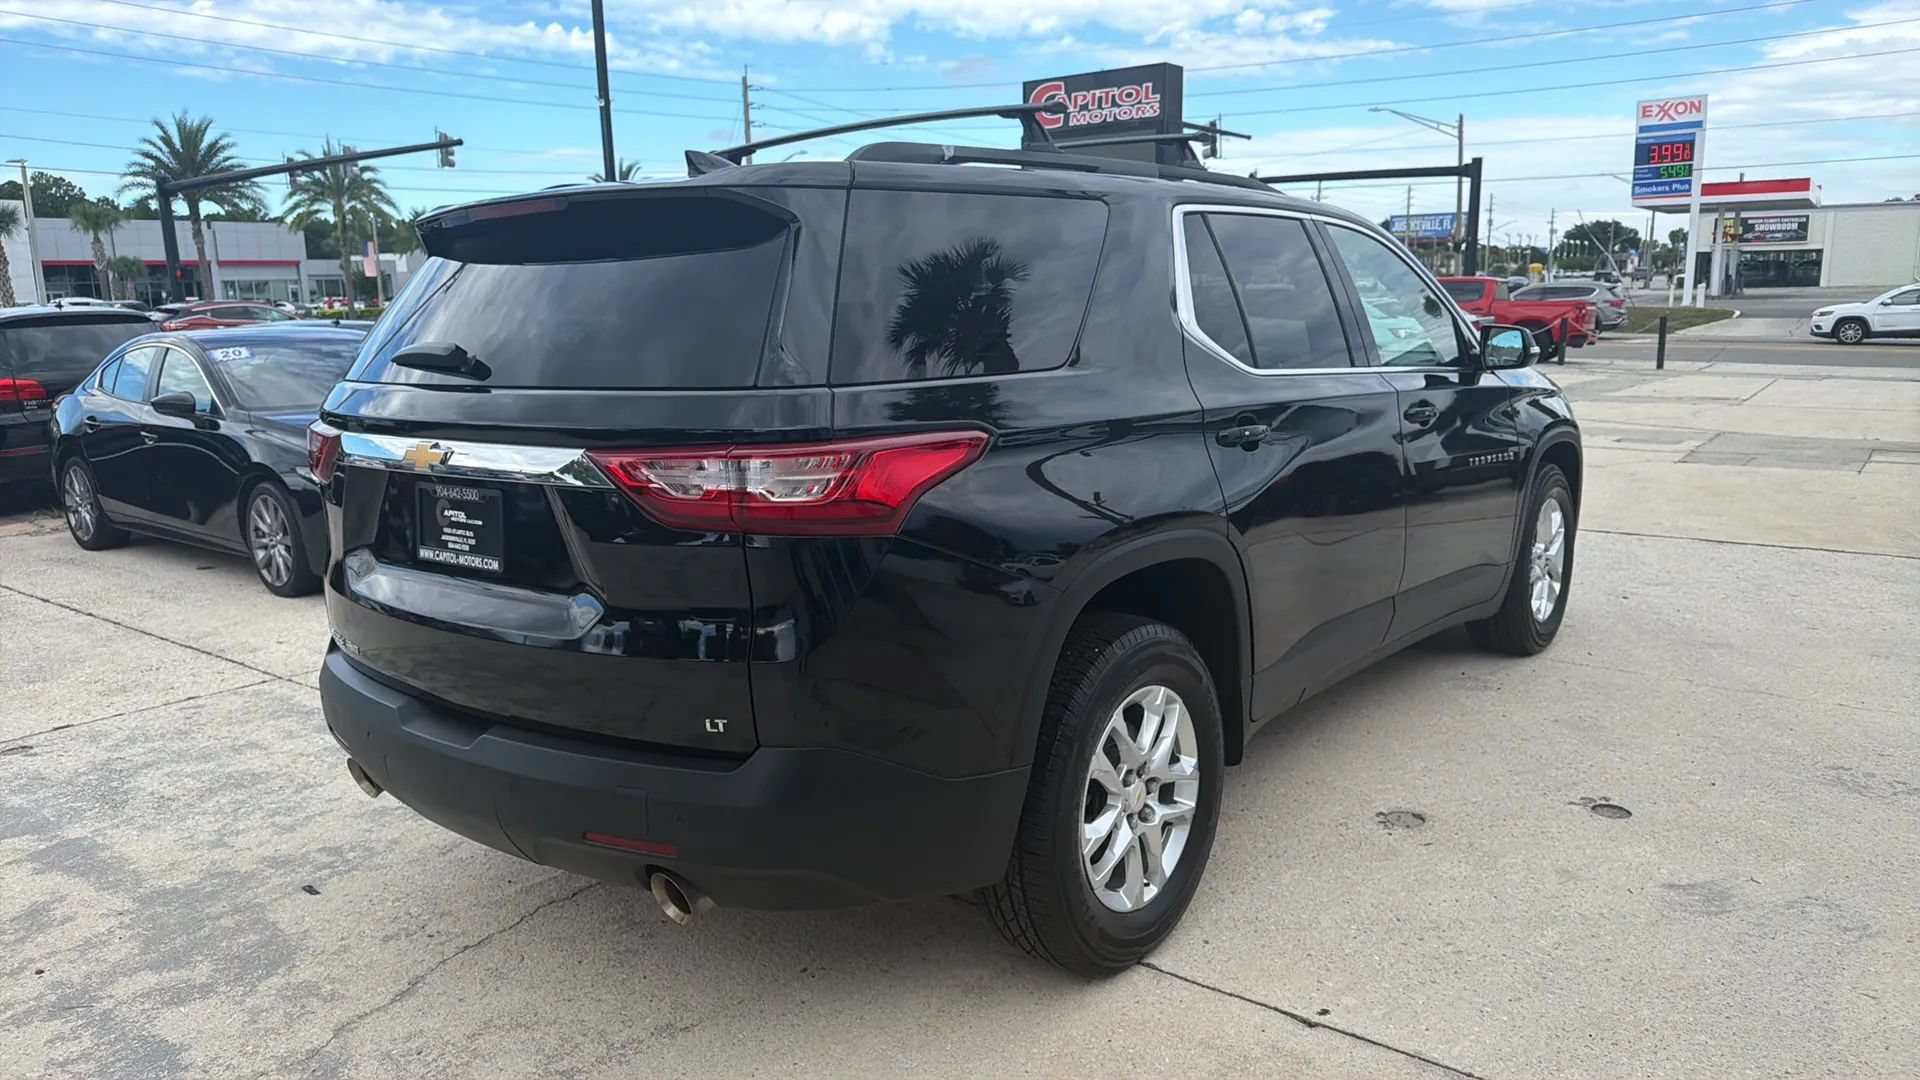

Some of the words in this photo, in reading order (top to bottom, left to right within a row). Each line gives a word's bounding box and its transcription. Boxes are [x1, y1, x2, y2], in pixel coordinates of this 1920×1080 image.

[1069, 103, 1160, 126] MOTORS
[1641, 100, 1702, 121] EXXON
[1634, 184, 1670, 194] Smokers
[1671, 183, 1690, 191] Plus
[1754, 222, 1798, 231] SHOWROOM
[220, 349, 242, 359] 20
[435, 485, 479, 501] 904-642-5500
[419, 548, 499, 570] WWW.CAPITOL-MOTORS.COM
[705, 719, 727, 732] LT
